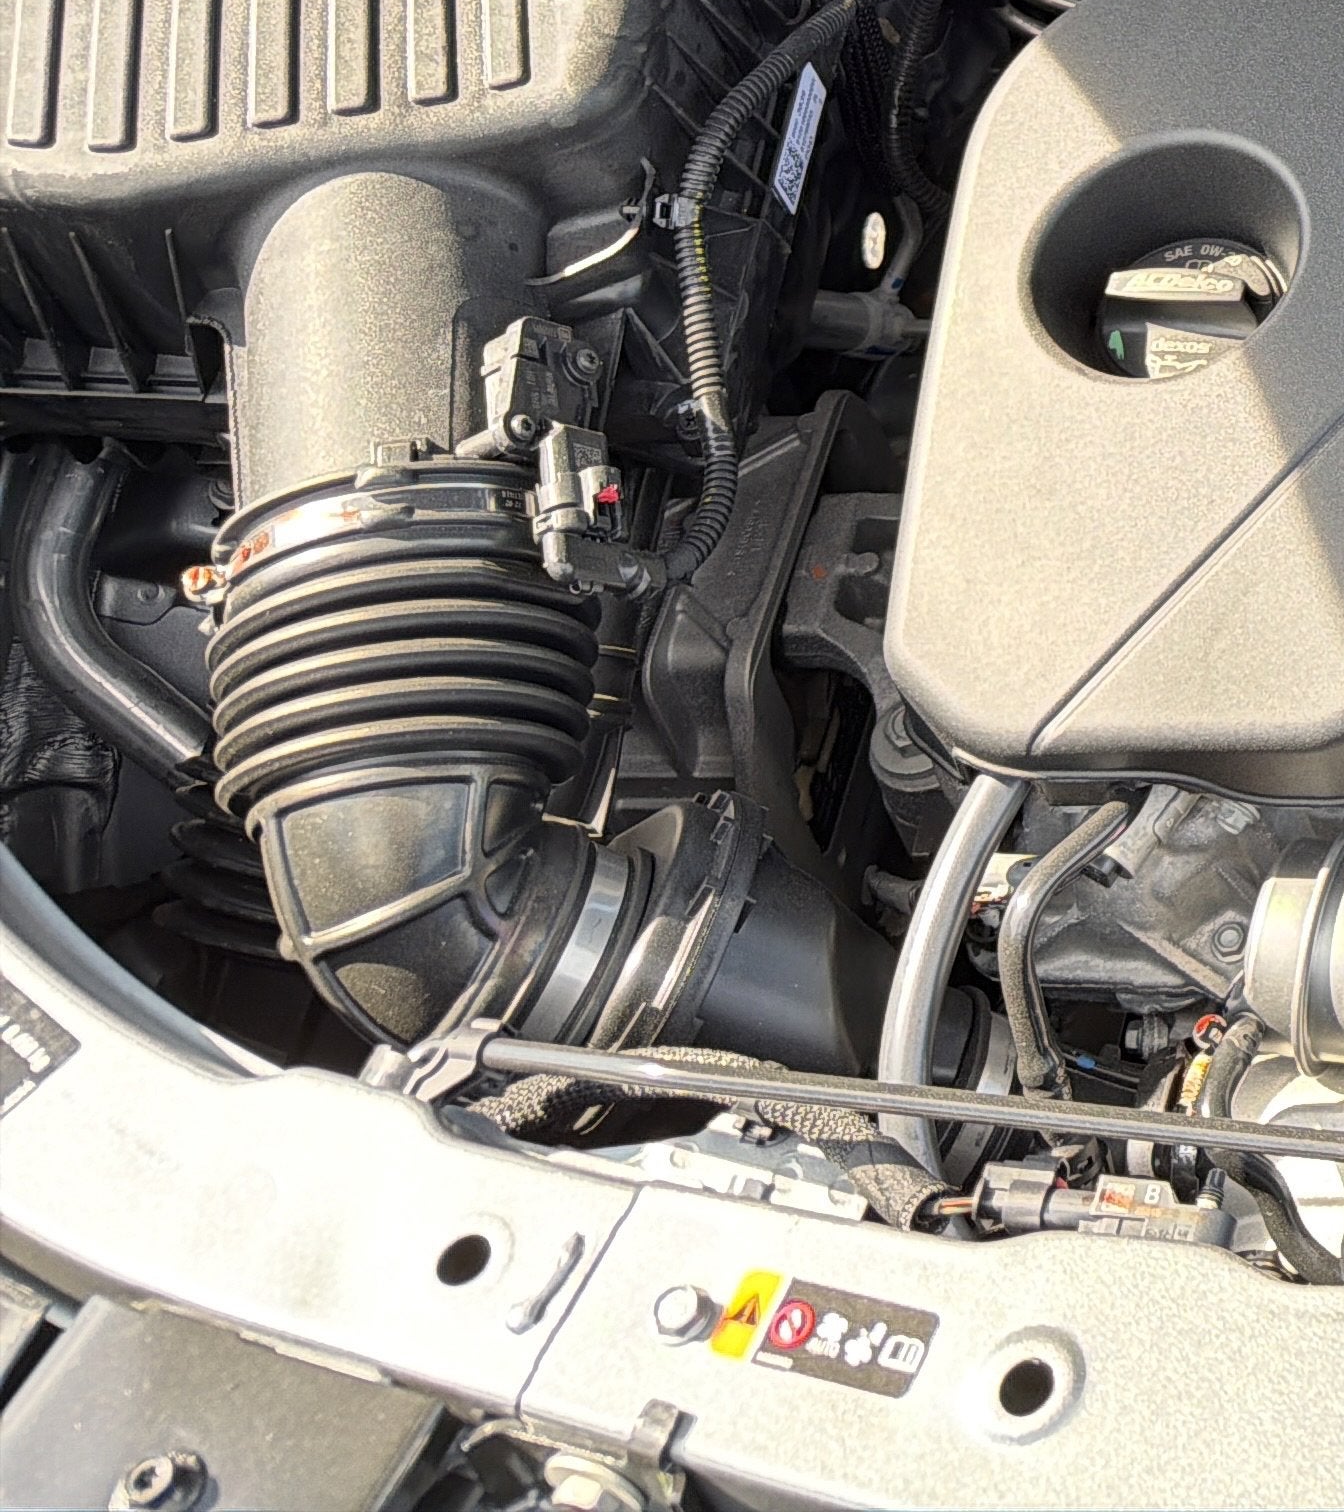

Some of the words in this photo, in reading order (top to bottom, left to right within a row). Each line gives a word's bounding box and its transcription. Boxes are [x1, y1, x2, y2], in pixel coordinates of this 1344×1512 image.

[1164, 245, 1193, 262] SAE
[1124, 272, 1234, 294] ACDelco
[1144, 1184, 1160, 1205] B
